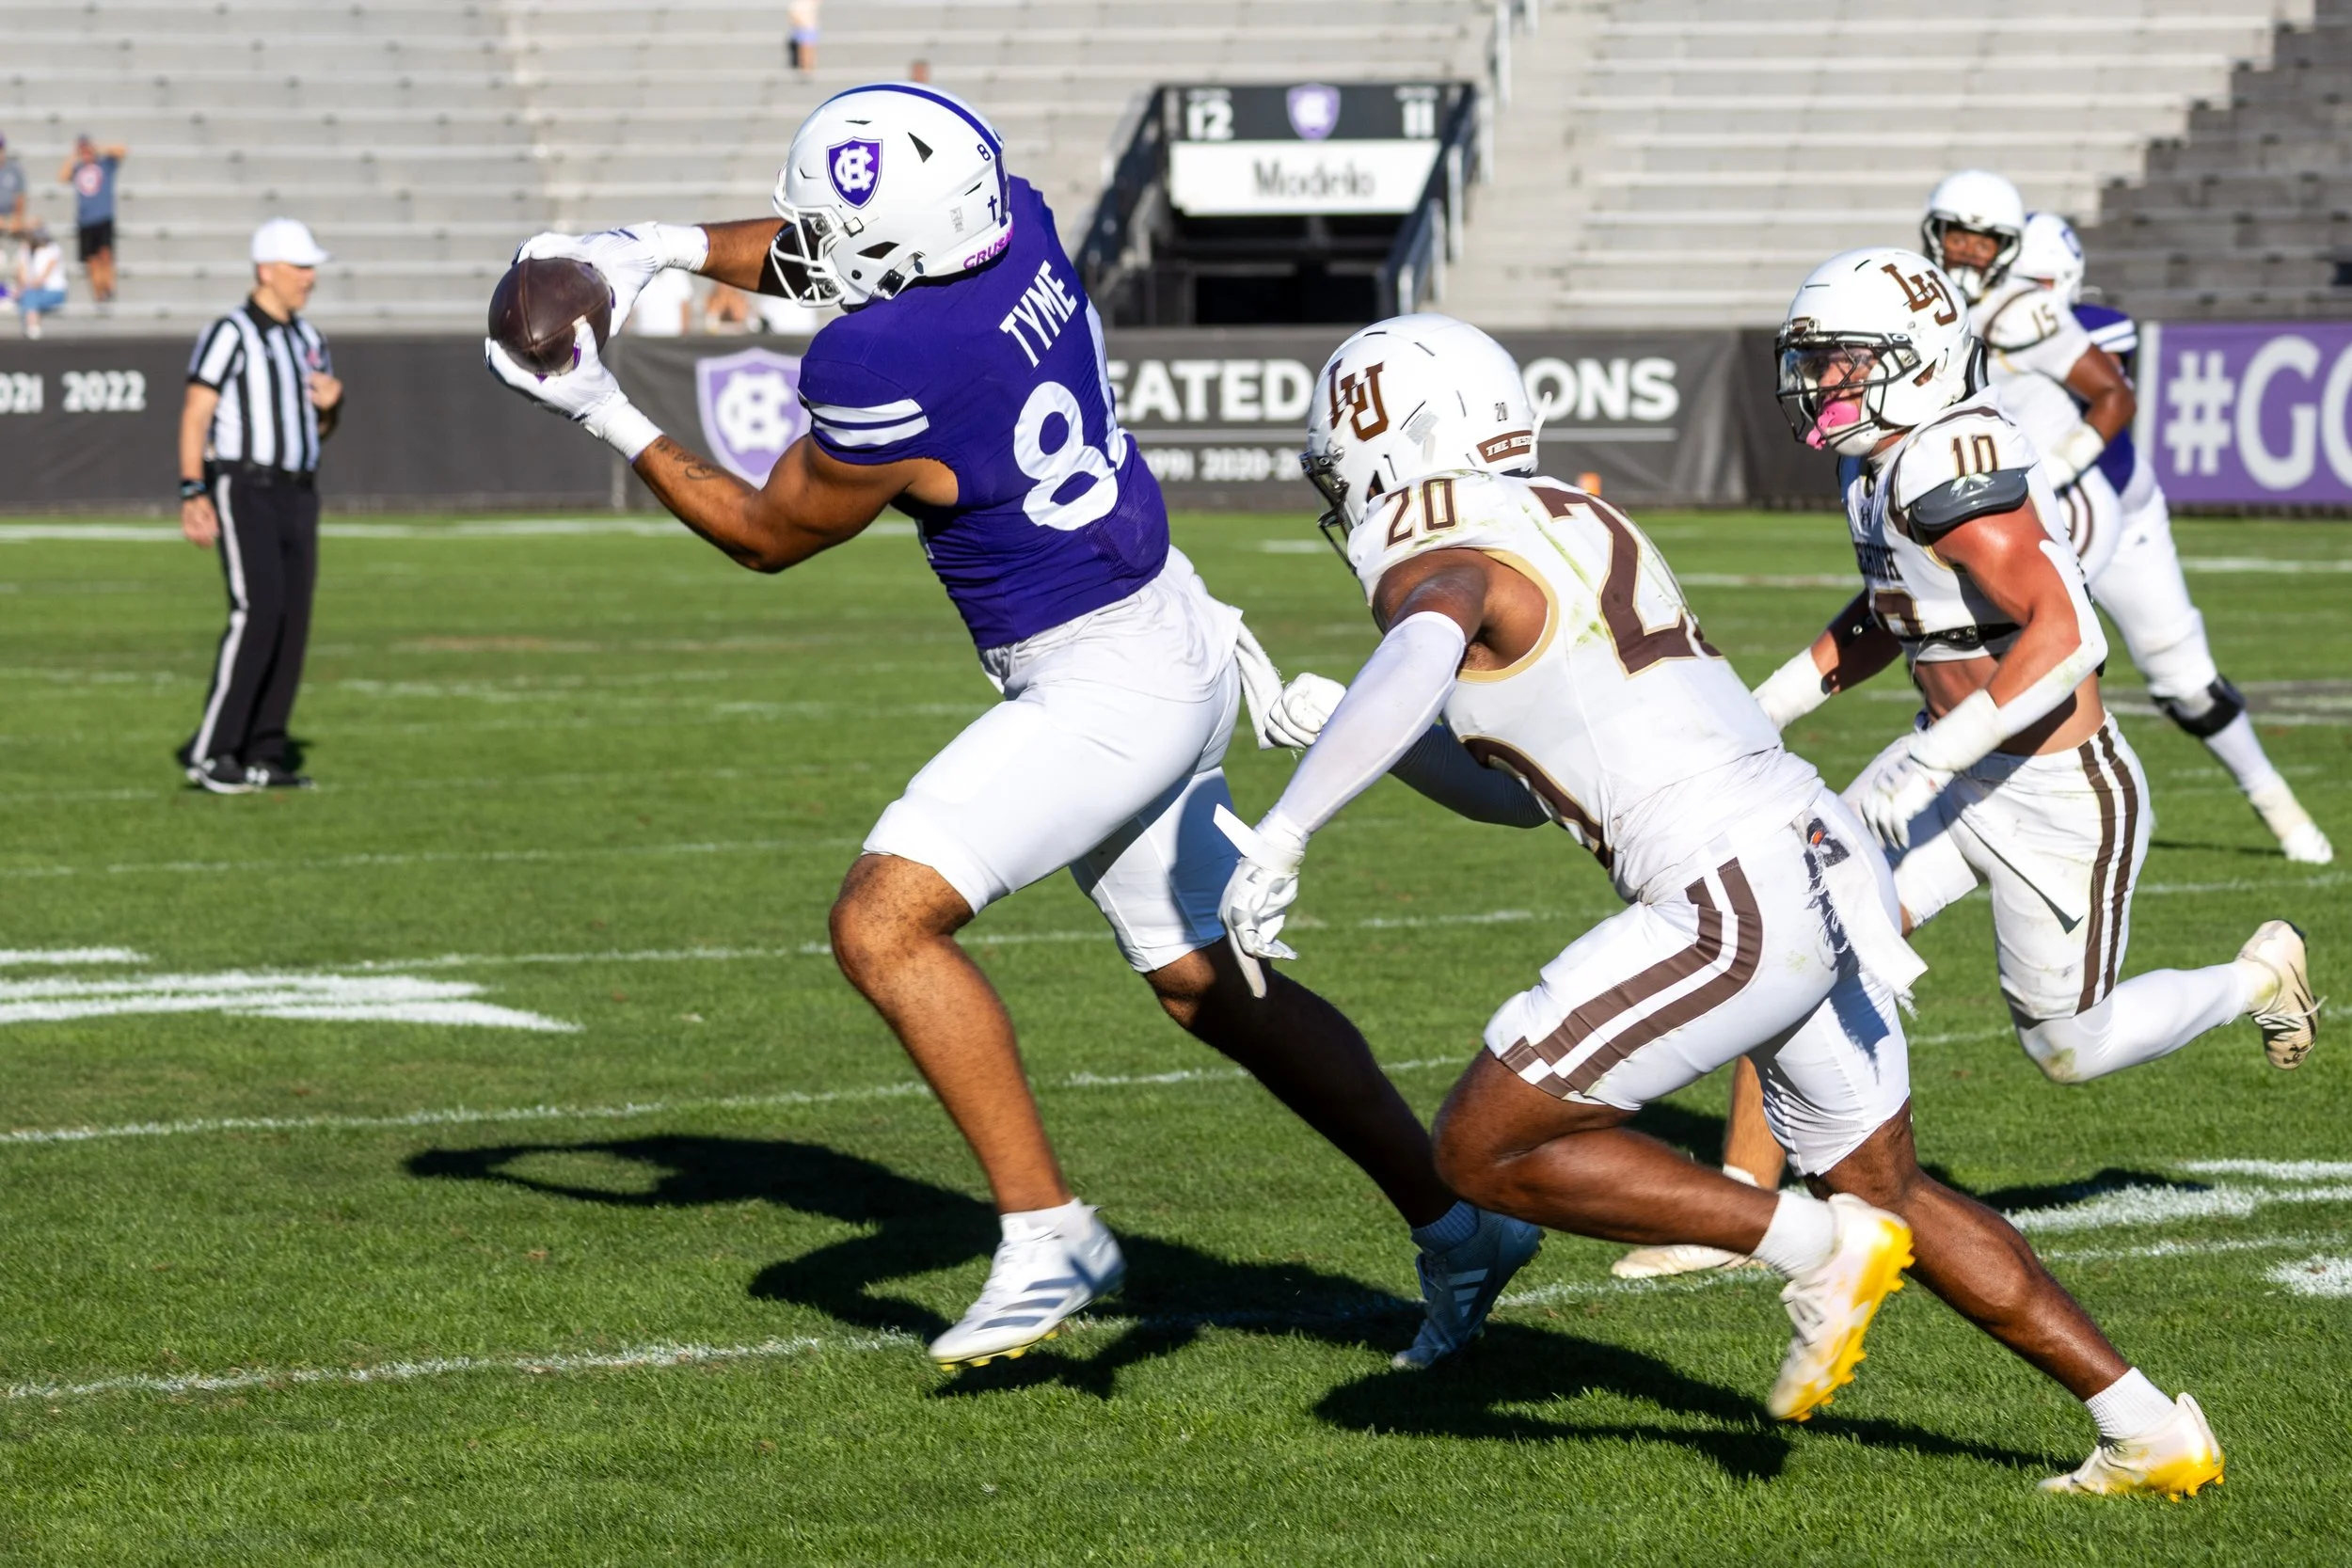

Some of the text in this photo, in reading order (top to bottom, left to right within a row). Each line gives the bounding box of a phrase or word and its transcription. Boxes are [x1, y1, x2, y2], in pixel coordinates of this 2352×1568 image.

[1186, 99, 1233, 141] 12
[1402, 100, 1436, 138] 11
[977, 143, 992, 161] 8
[999, 260, 1078, 368] TYME
[61, 370, 147, 413] 2022
[1494, 402, 1508, 422] 20
[1951, 433, 2000, 478] 10
[1384, 477, 1458, 551] 20
[1528, 484, 1725, 680] 2
